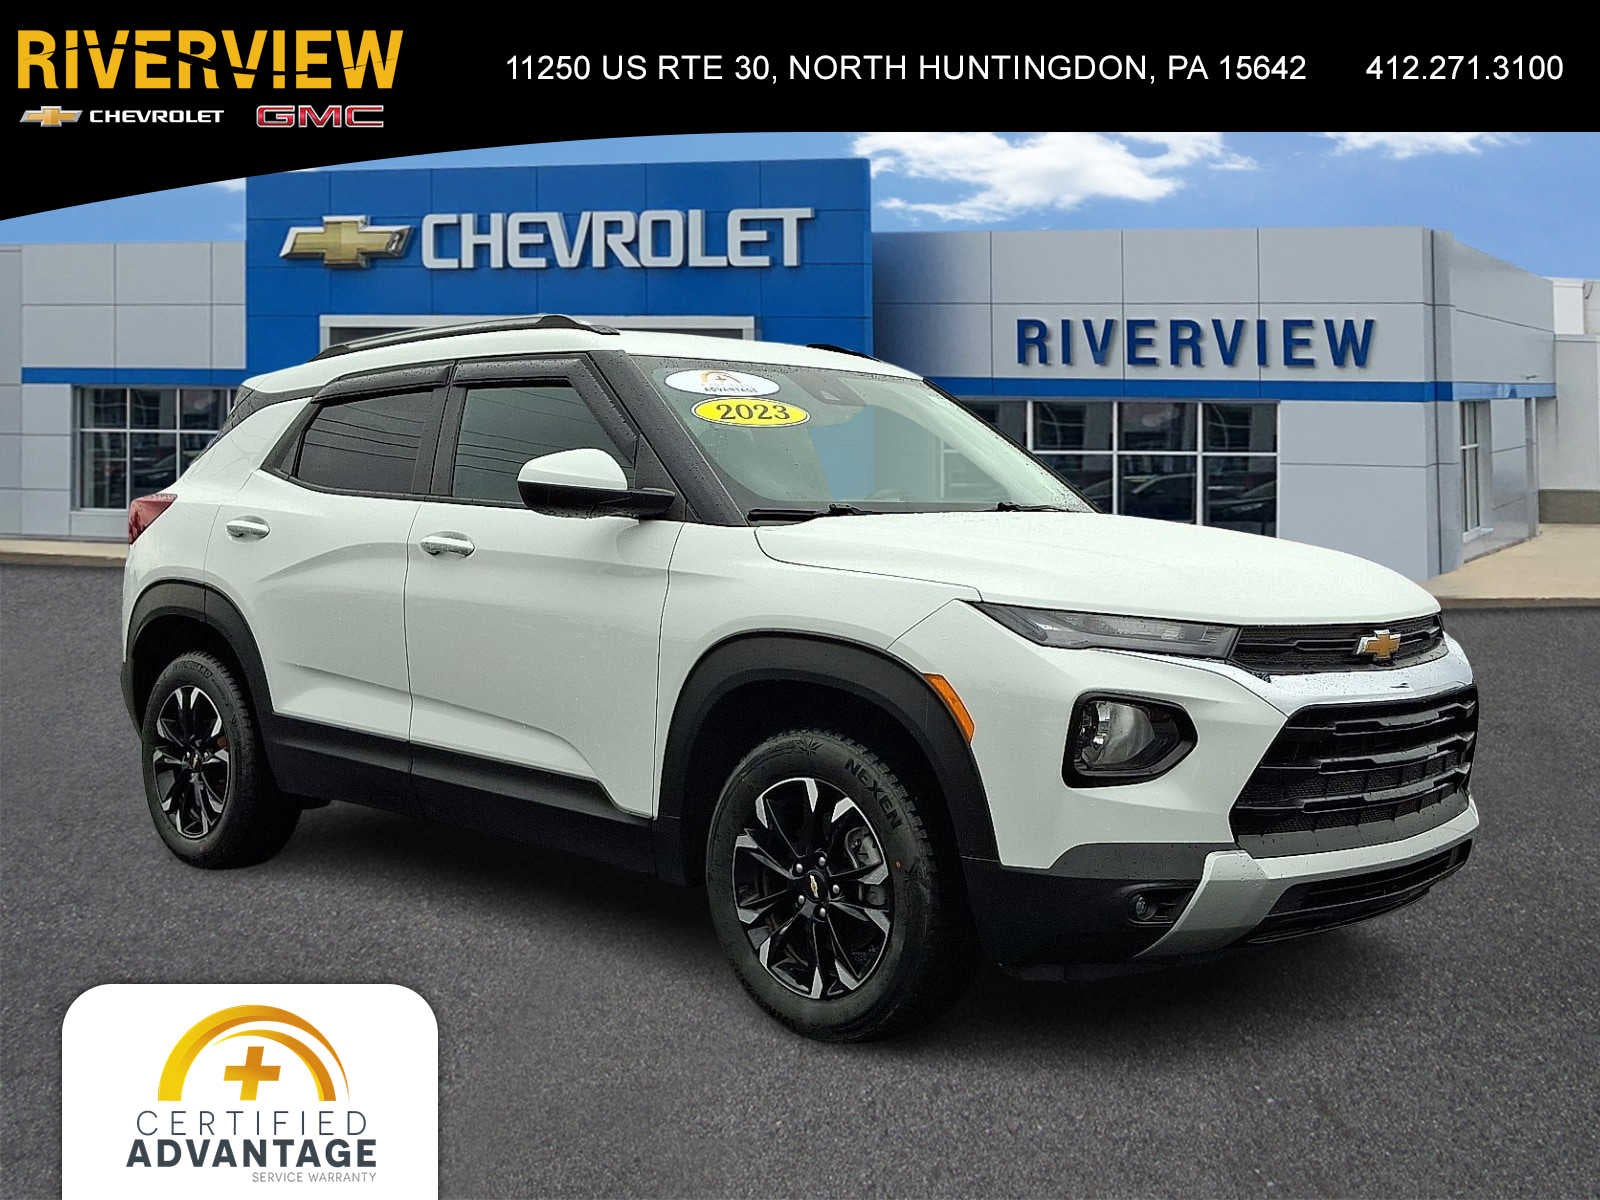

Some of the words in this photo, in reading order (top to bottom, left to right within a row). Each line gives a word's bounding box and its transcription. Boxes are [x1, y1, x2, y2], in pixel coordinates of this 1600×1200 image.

[421, 207, 814, 270] CHEVROLET
[1016, 318, 1375, 367] RIVERVIEW
[715, 403, 791, 420] 2023
[844, 757, 903, 830] NEXEN
